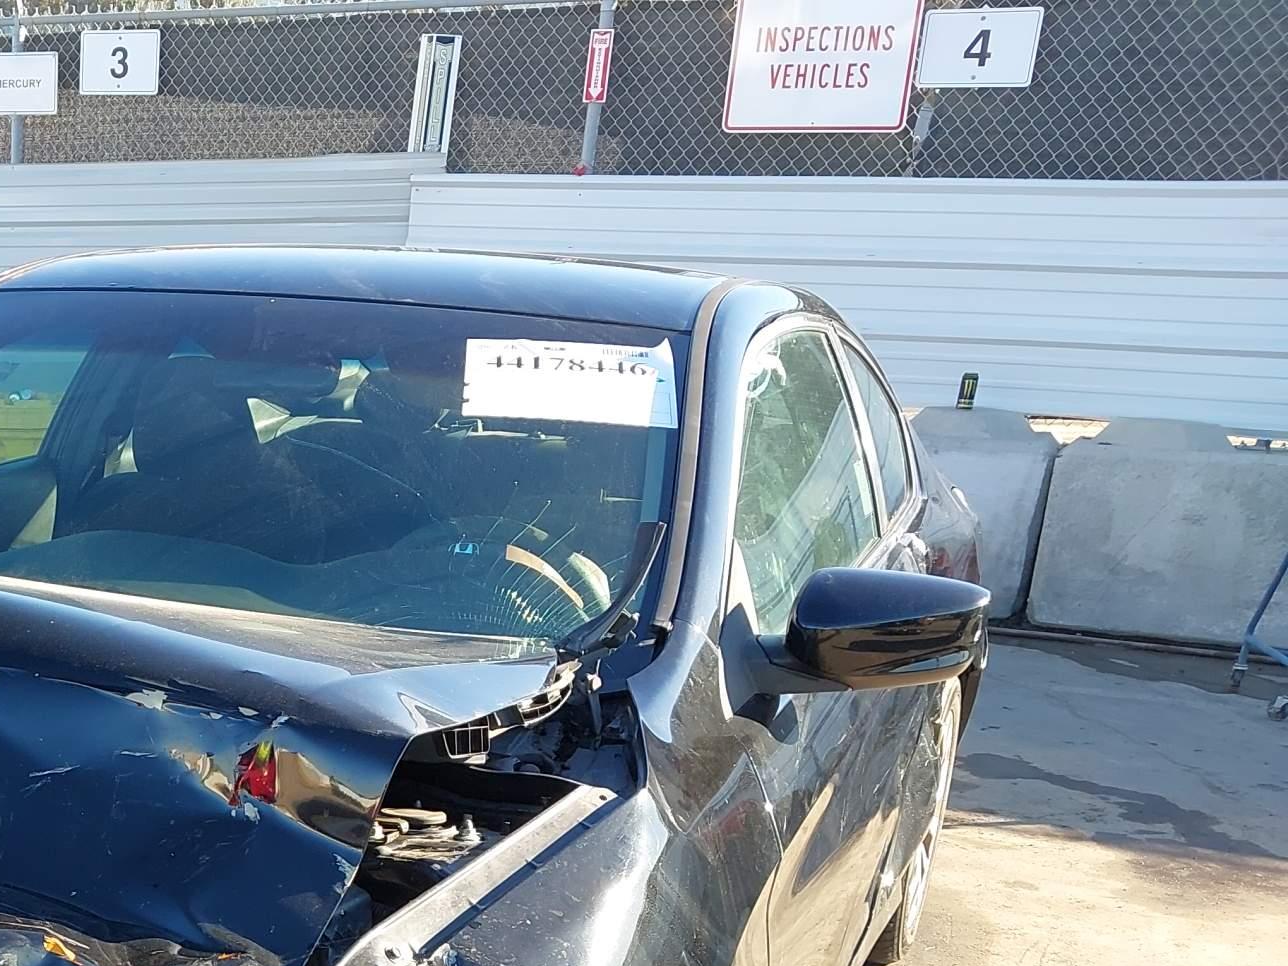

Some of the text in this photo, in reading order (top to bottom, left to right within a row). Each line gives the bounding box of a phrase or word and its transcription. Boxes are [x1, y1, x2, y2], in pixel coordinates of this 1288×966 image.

[755, 25, 896, 53] INSPECTIONS
[963, 29, 992, 67] 4
[110, 46, 129, 79] 3
[769, 62, 871, 89] VEHICLES
